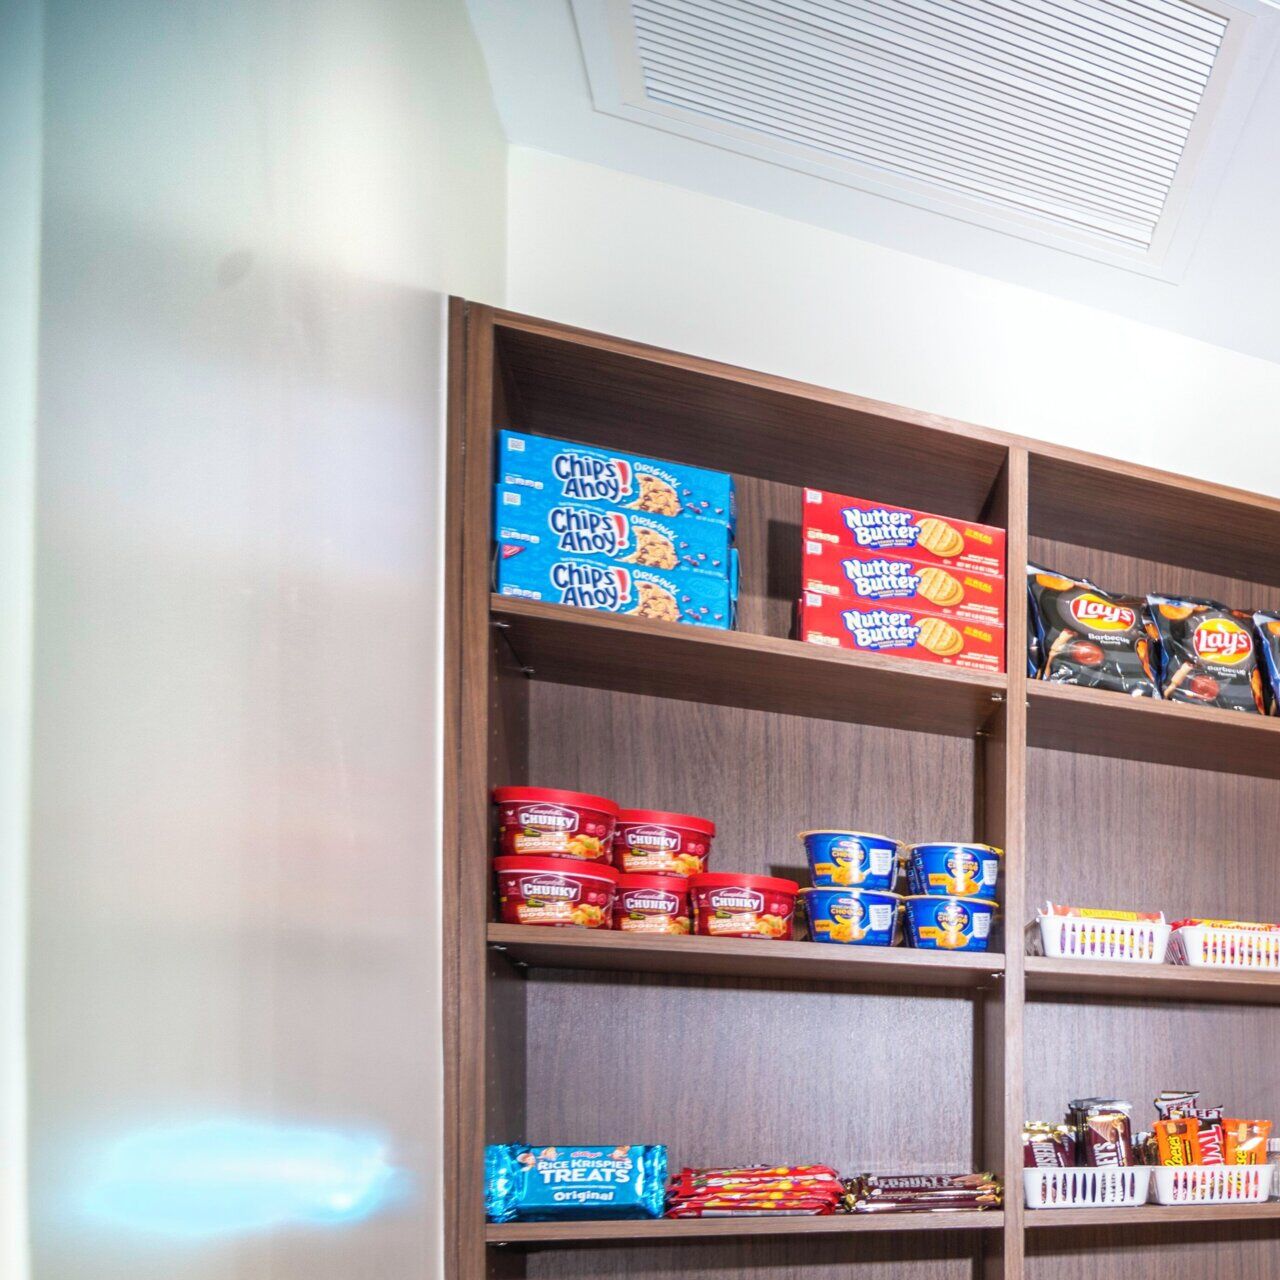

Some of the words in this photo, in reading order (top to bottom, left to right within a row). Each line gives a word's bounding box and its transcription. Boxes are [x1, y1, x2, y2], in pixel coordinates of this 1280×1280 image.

[554, 454, 616, 480] Chips
[634, 462, 681, 488] ORIGINAL
[551, 507, 613, 533] Chips
[631, 515, 679, 541] ORIGINAL
[842, 509, 912, 528] Nutter
[854, 524, 921, 545] Butter
[553, 562, 614, 588] Chips
[842, 560, 912, 579] Nutter
[633, 570, 681, 595] ORIGINAL
[854, 575, 921, 596] Butter
[842, 611, 912, 630] Nutter
[854, 625, 921, 647] Butter
[521, 813, 574, 828] CHUNKY
[627, 833, 677, 848] CHUNKY
[523, 883, 577, 898] CHUNKY
[626, 897, 675, 911] CHUNKY
[712, 895, 760, 910] CHUNKY
[538, 1160, 569, 1170] RICE
[571, 1159, 633, 1170] KRISPIES
[540, 1168, 630, 1184] TREATS
[553, 1191, 614, 1202] Original
